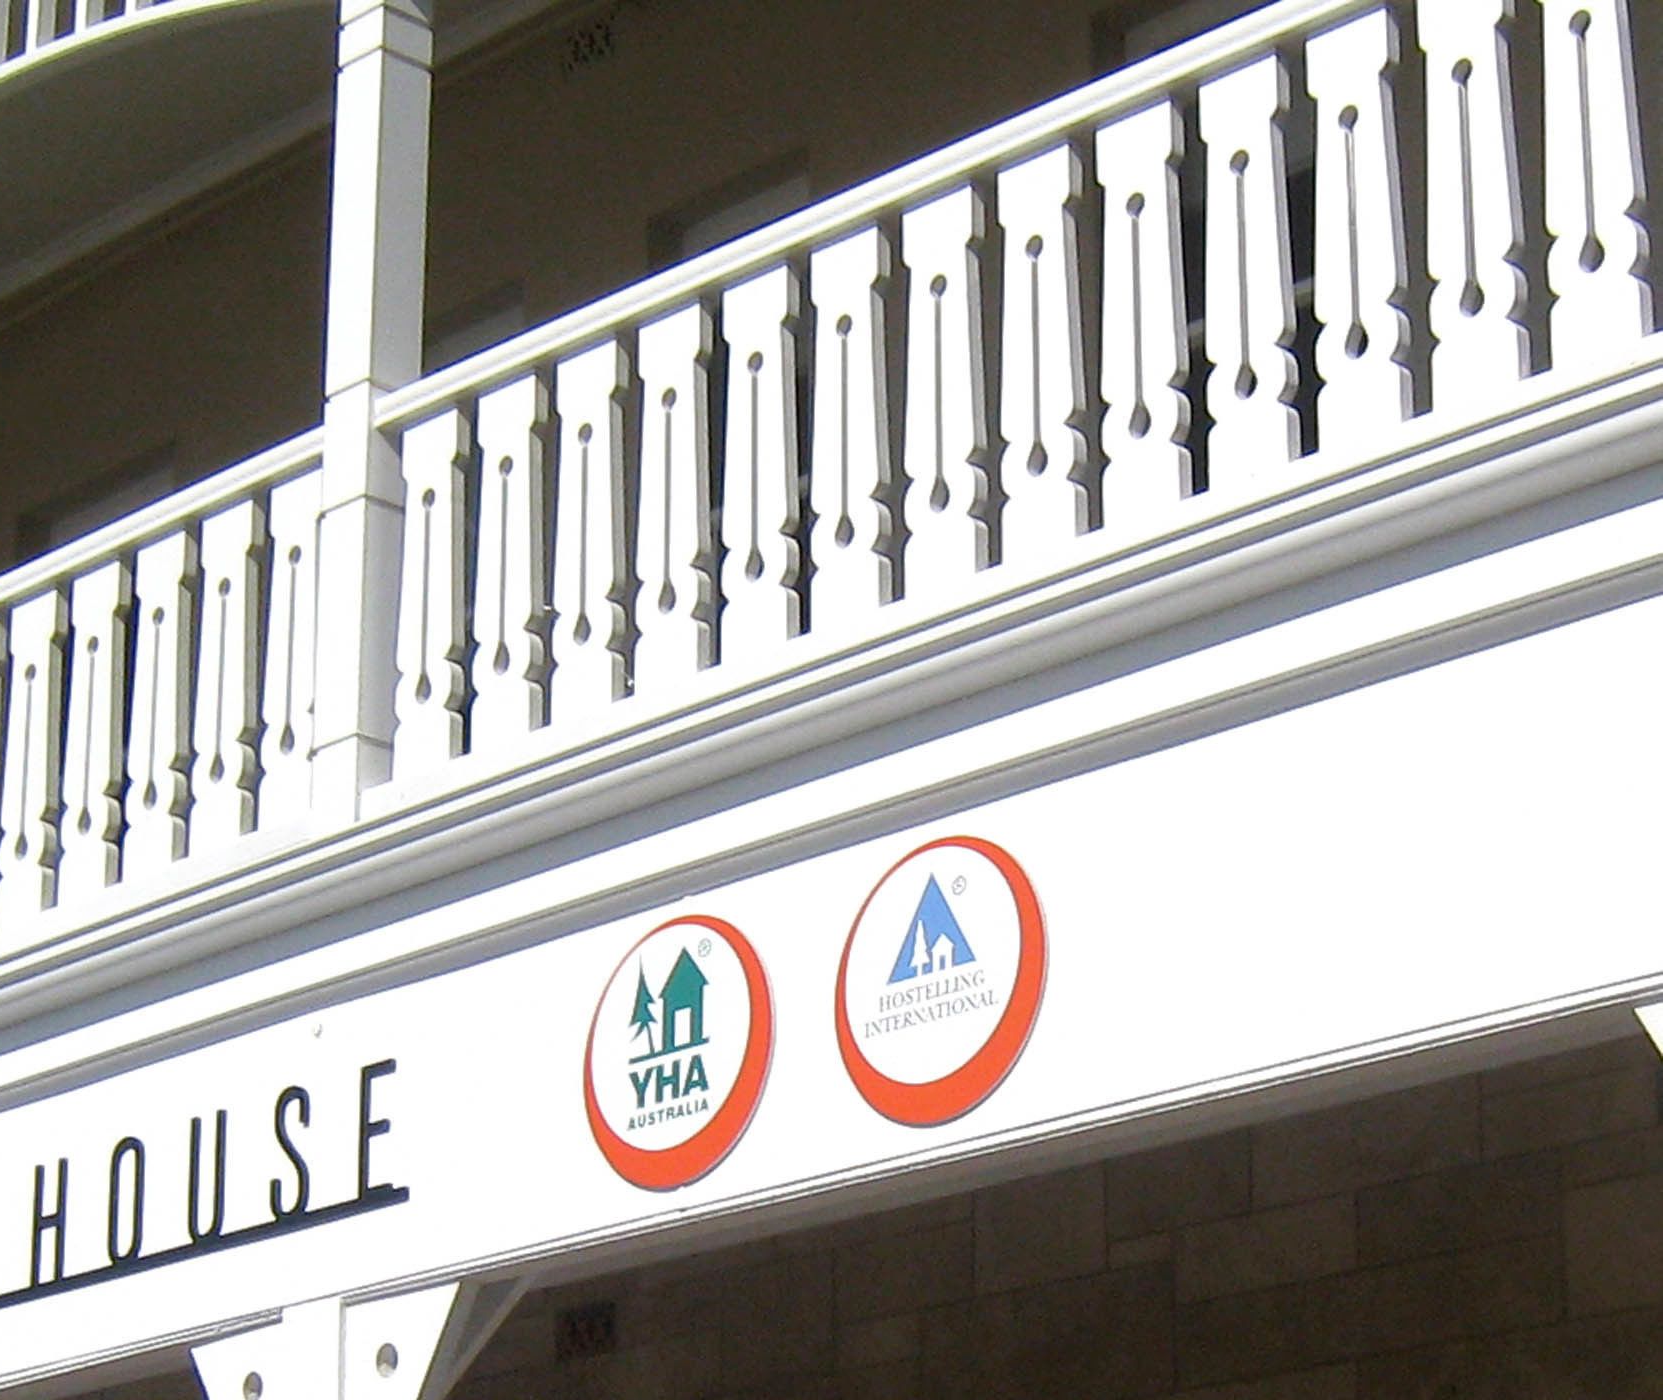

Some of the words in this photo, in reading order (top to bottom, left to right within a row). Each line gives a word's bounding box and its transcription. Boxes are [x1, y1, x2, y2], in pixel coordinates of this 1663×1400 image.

[864, 990, 999, 1038] INTERNATIONAL
[879, 970, 985, 1012] HOSTELLING
[628, 1054, 709, 1109] YHA
[627, 1098, 709, 1130] AUSTRALIA
[29, 1058, 404, 1288] HOUSE
